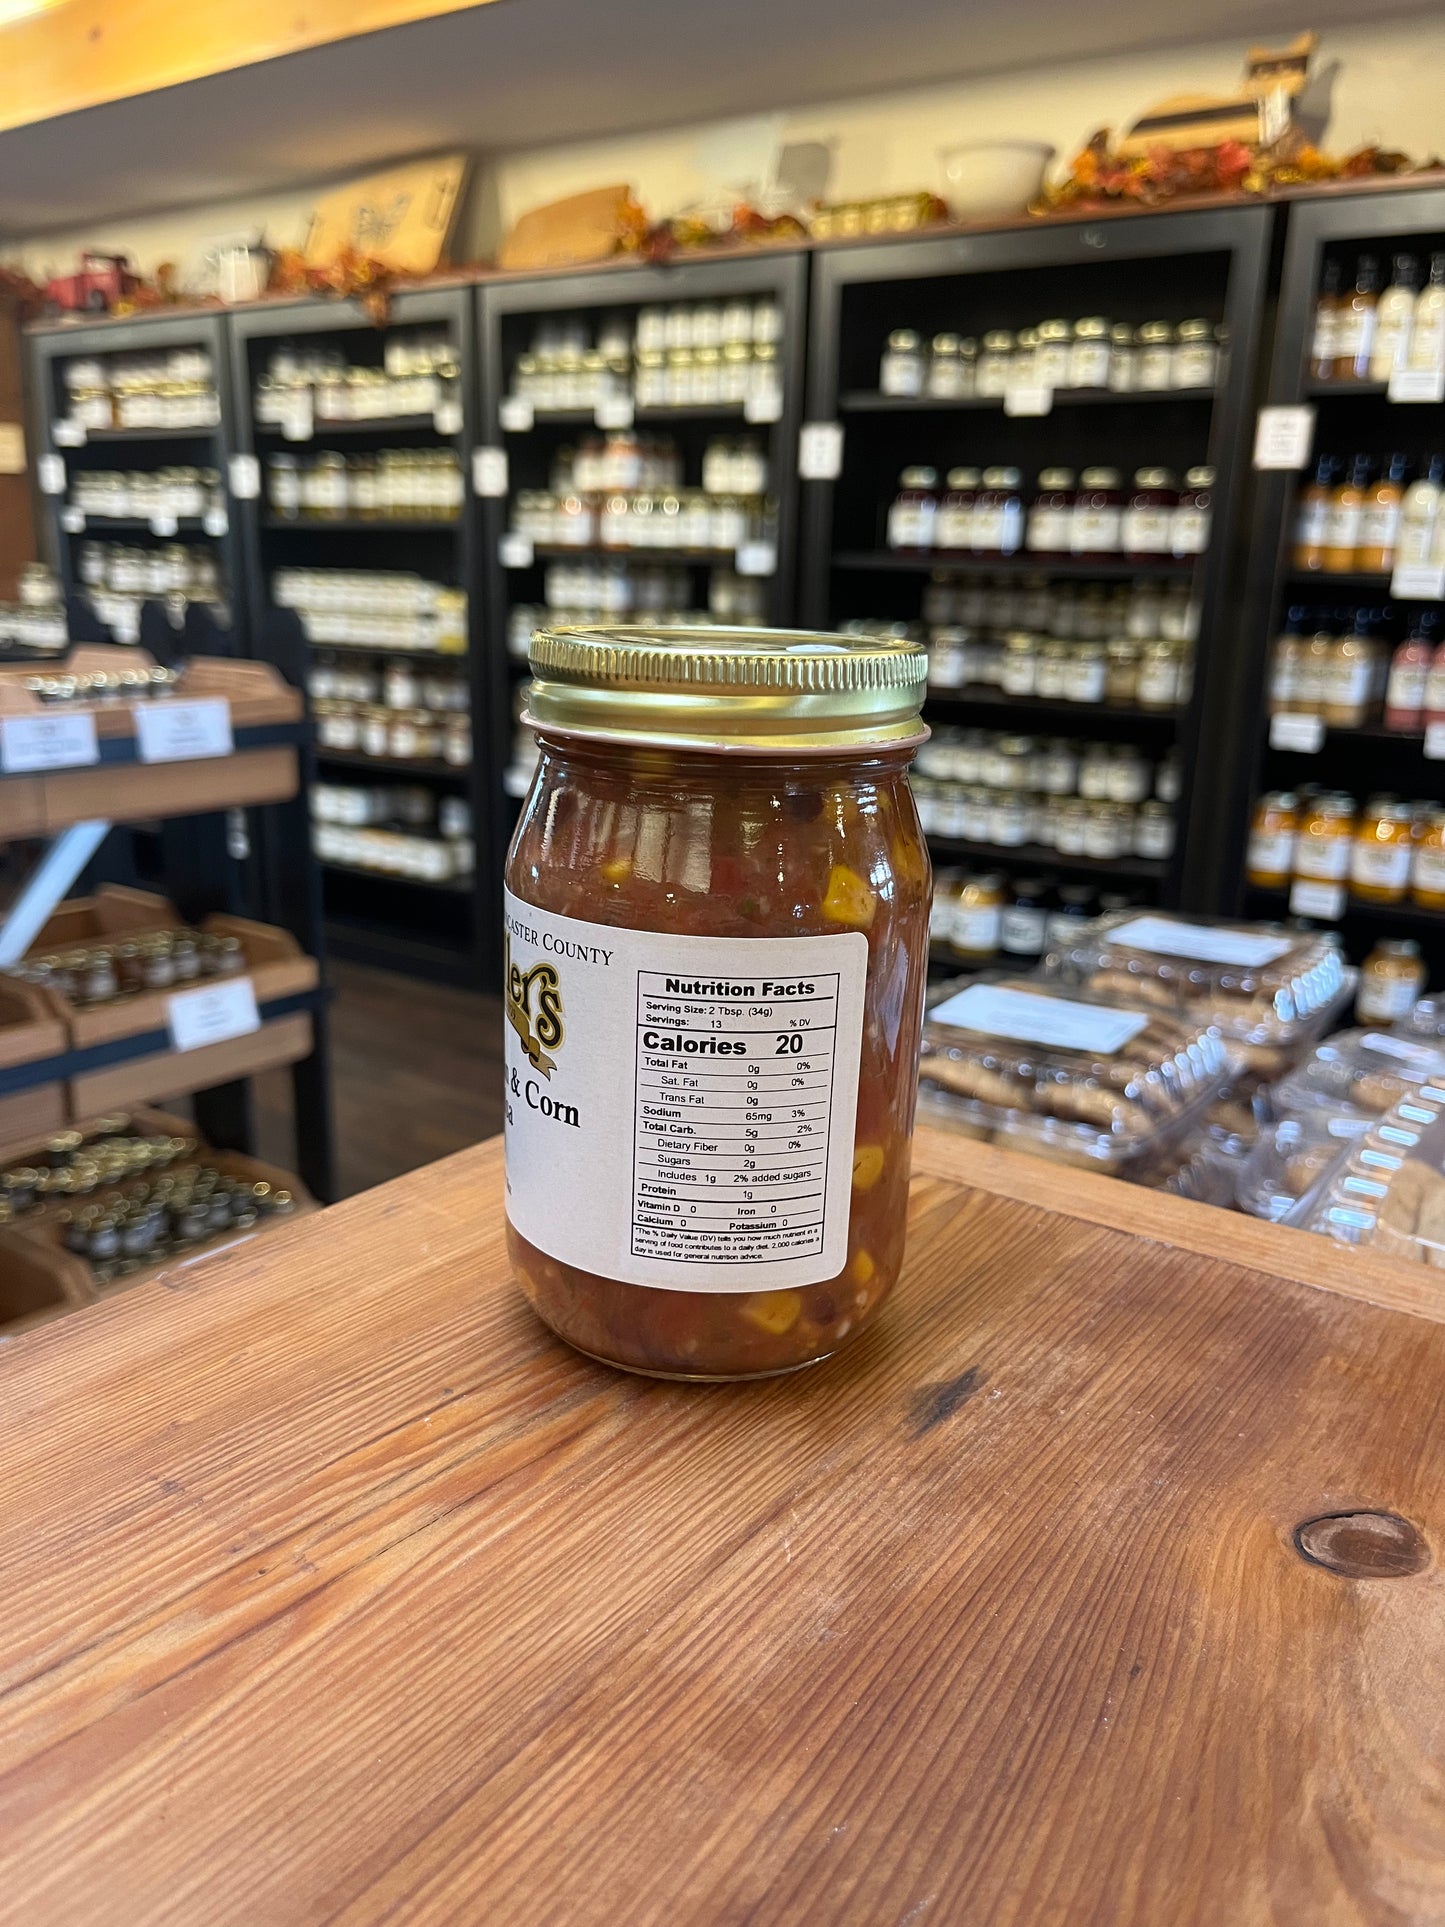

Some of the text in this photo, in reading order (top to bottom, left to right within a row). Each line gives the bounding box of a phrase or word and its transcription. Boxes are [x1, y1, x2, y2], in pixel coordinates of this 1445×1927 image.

[506, 912, 614, 966] CASTER COUNTY
[666, 978, 815, 996] Nutrition Facts
[646, 1002, 681, 1014] Serving
[684, 1006, 707, 1014] Size:
[718, 1007, 744, 1017] Tbsp.
[748, 1008, 773, 1017] (34g)
[646, 1014, 690, 1027] Servings:
[643, 1032, 804, 1054] Calories 20
[644, 1057, 810, 1074] Total Fat 0g 0%
[661, 1076, 804, 1090] Sat. Fat 0g 0%
[511, 1067, 520, 1098] &
[526, 1080, 580, 1128] Corn
[660, 1092, 758, 1106] Trans Fat 0g
[643, 1106, 806, 1121] Sodium 65mg 3%
[643, 1121, 812, 1138] Total Carb. 5g 2%
[657, 1138, 802, 1153] Dietary Fiber 0g 0%
[657, 1154, 756, 1168] Sugars 2g
[658, 1170, 812, 1184] Includes 1g 2% added sugars
[641, 1183, 753, 1200] Protein 1g
[638, 1200, 671, 1211] Vitamin
[637, 1214, 674, 1226] Calcium
[729, 1222, 777, 1230] Potassium
[660, 1231, 678, 1239] Daily
[782, 1230, 806, 1238] nutrient
[634, 1238, 658, 1247] serving
[791, 1238, 814, 1246] calories
[634, 1246, 646, 1254] day
